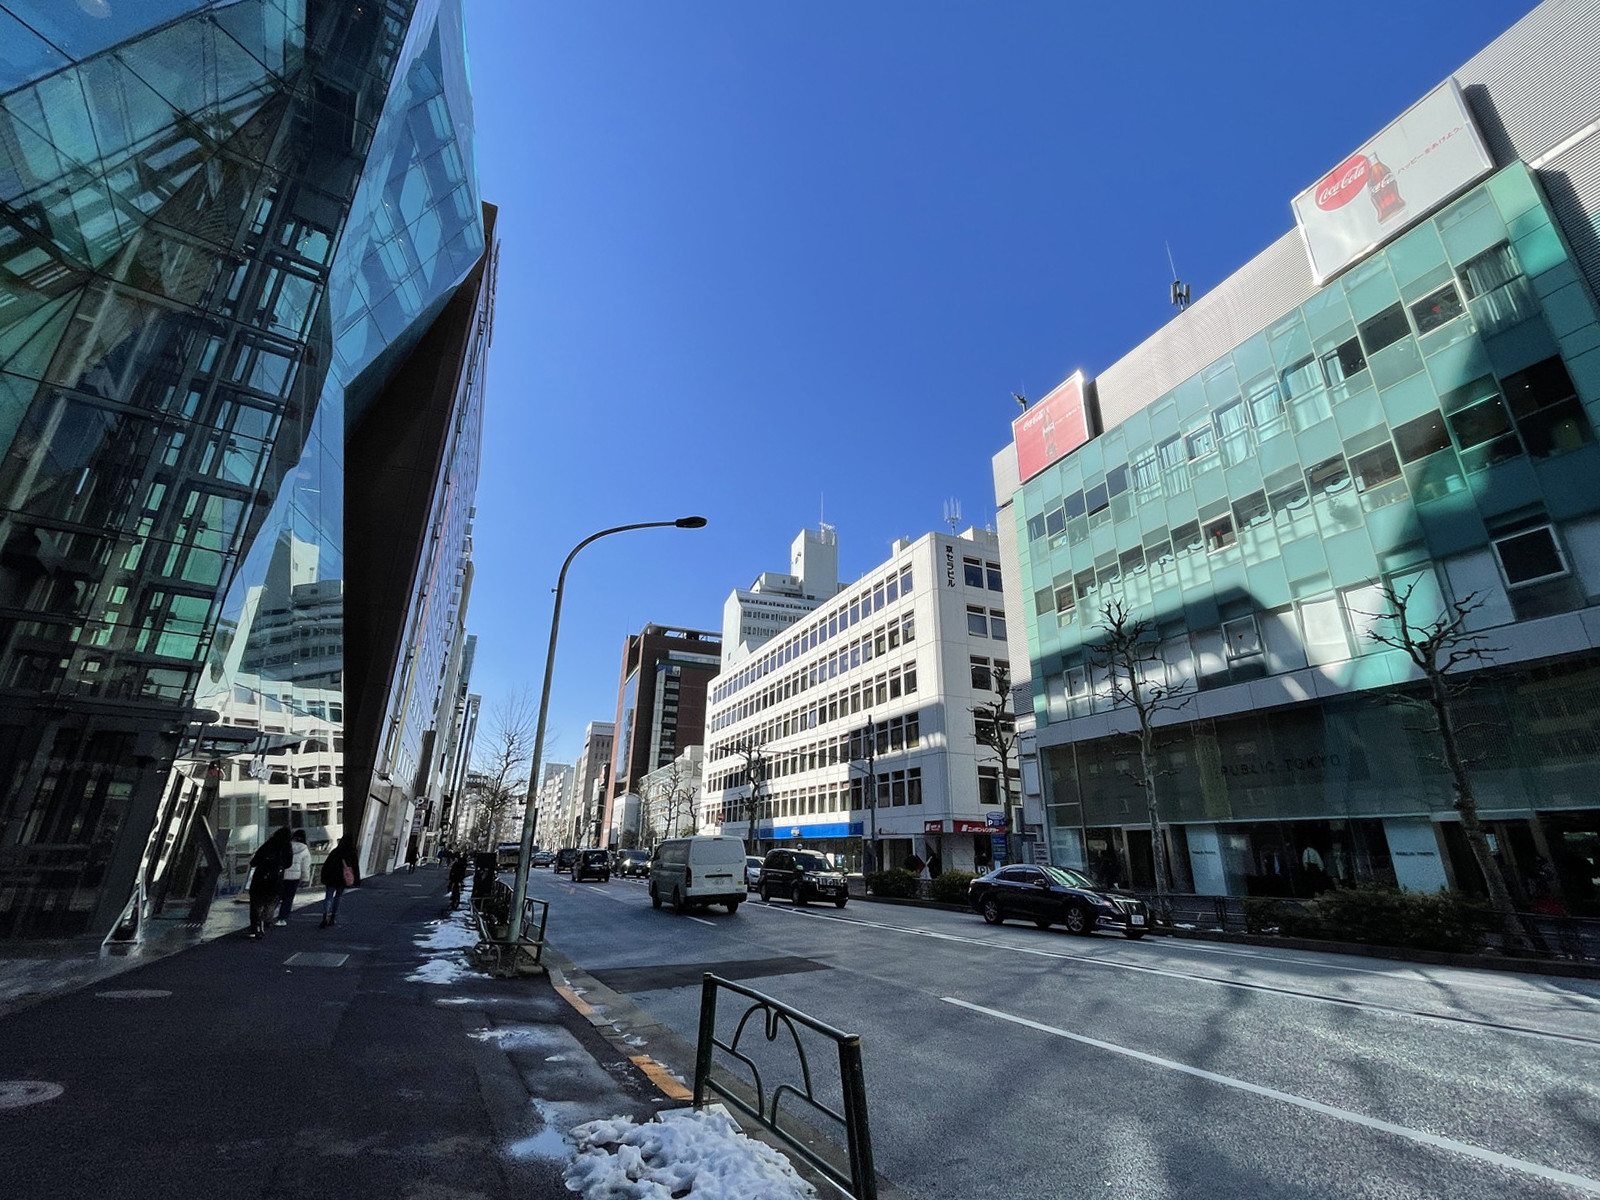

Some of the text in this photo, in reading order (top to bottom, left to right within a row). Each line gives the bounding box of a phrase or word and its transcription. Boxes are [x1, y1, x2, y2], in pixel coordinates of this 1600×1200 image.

[1318, 159, 1367, 205] Coca-Cola
[945, 545, 956, 588] 京セラビル
[1220, 753, 1341, 776] PUBLIC TOKYO
